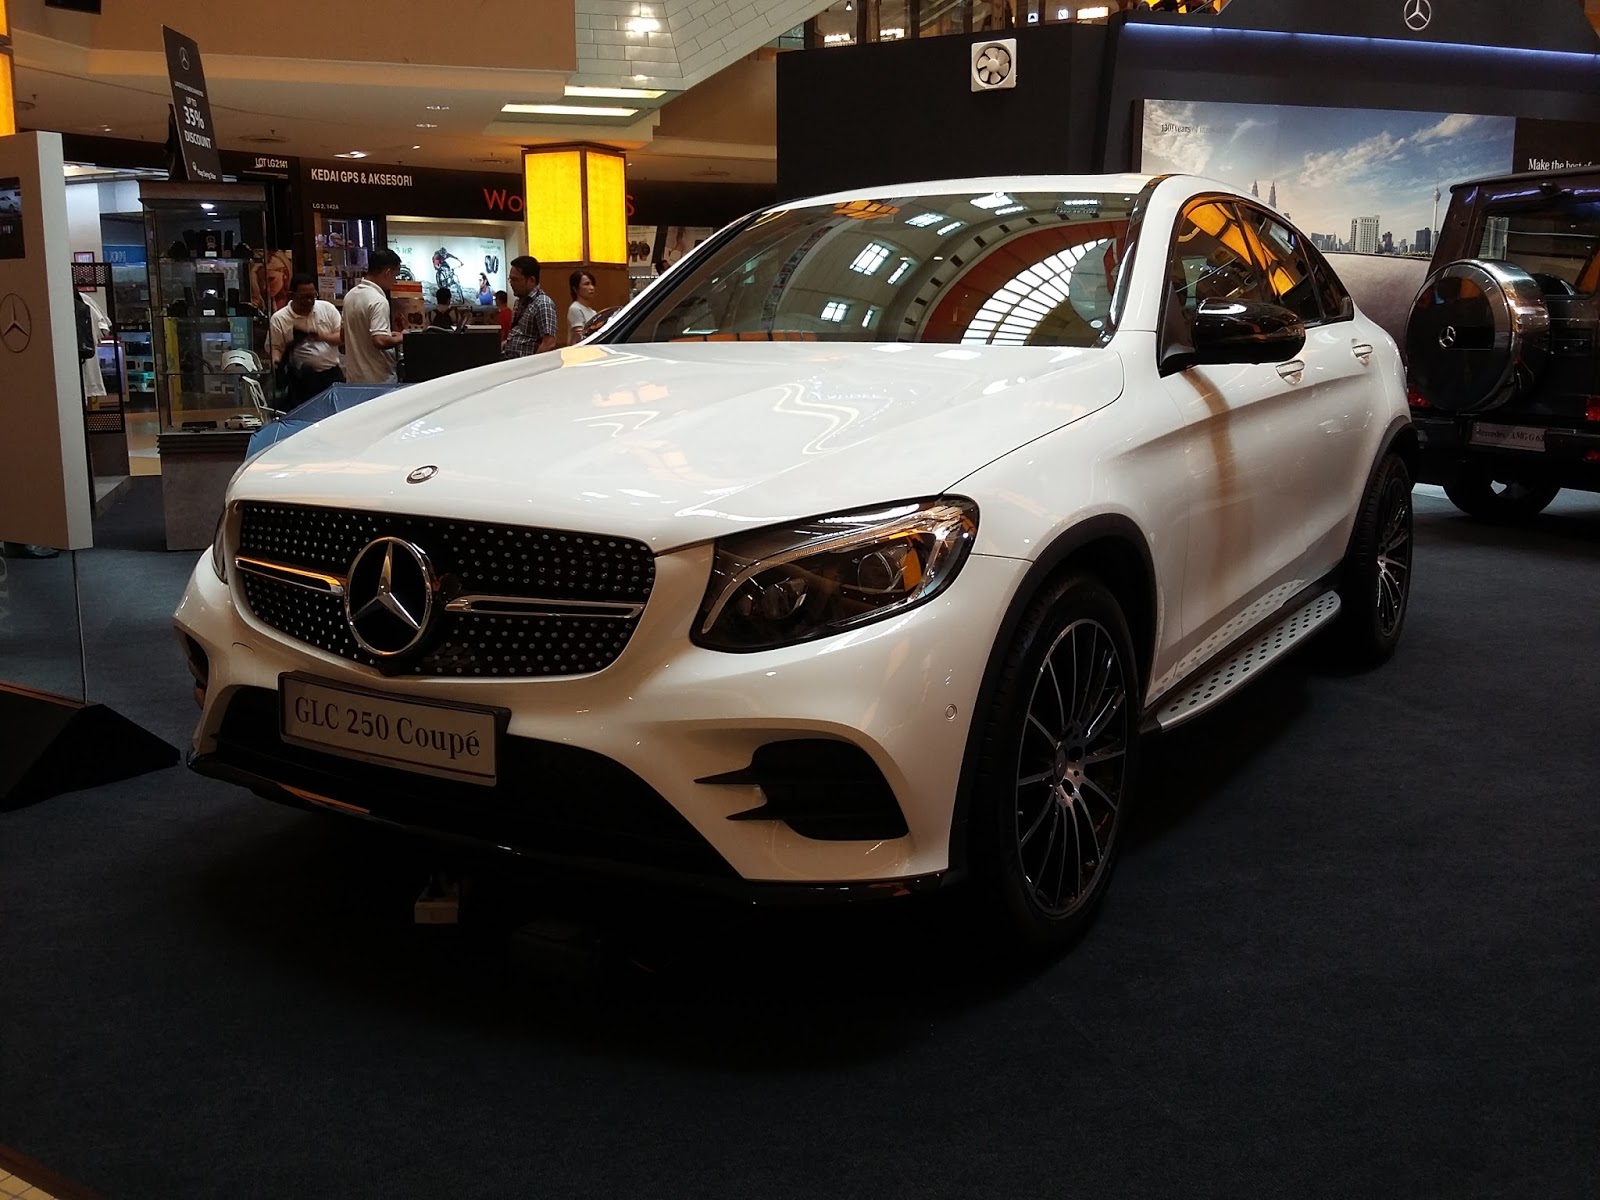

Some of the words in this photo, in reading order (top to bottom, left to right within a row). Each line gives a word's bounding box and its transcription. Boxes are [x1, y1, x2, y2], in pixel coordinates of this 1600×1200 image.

[183, 105, 205, 129] 35%
[184, 130, 211, 149] DISCOUNT
[255, 157, 266, 168] LOT
[1528, 158, 1550, 171] Make
[1551, 160, 1564, 170] the
[311, 168, 339, 182] KEDAI
[340, 170, 359, 183] GPS
[360, 172, 367, 184] &
[367, 173, 413, 187] AKSESORI
[482, 188, 524, 213] Wo
[295, 696, 340, 730] GLC
[346, 708, 389, 740] 250
[396, 717, 480, 760] Coupé
